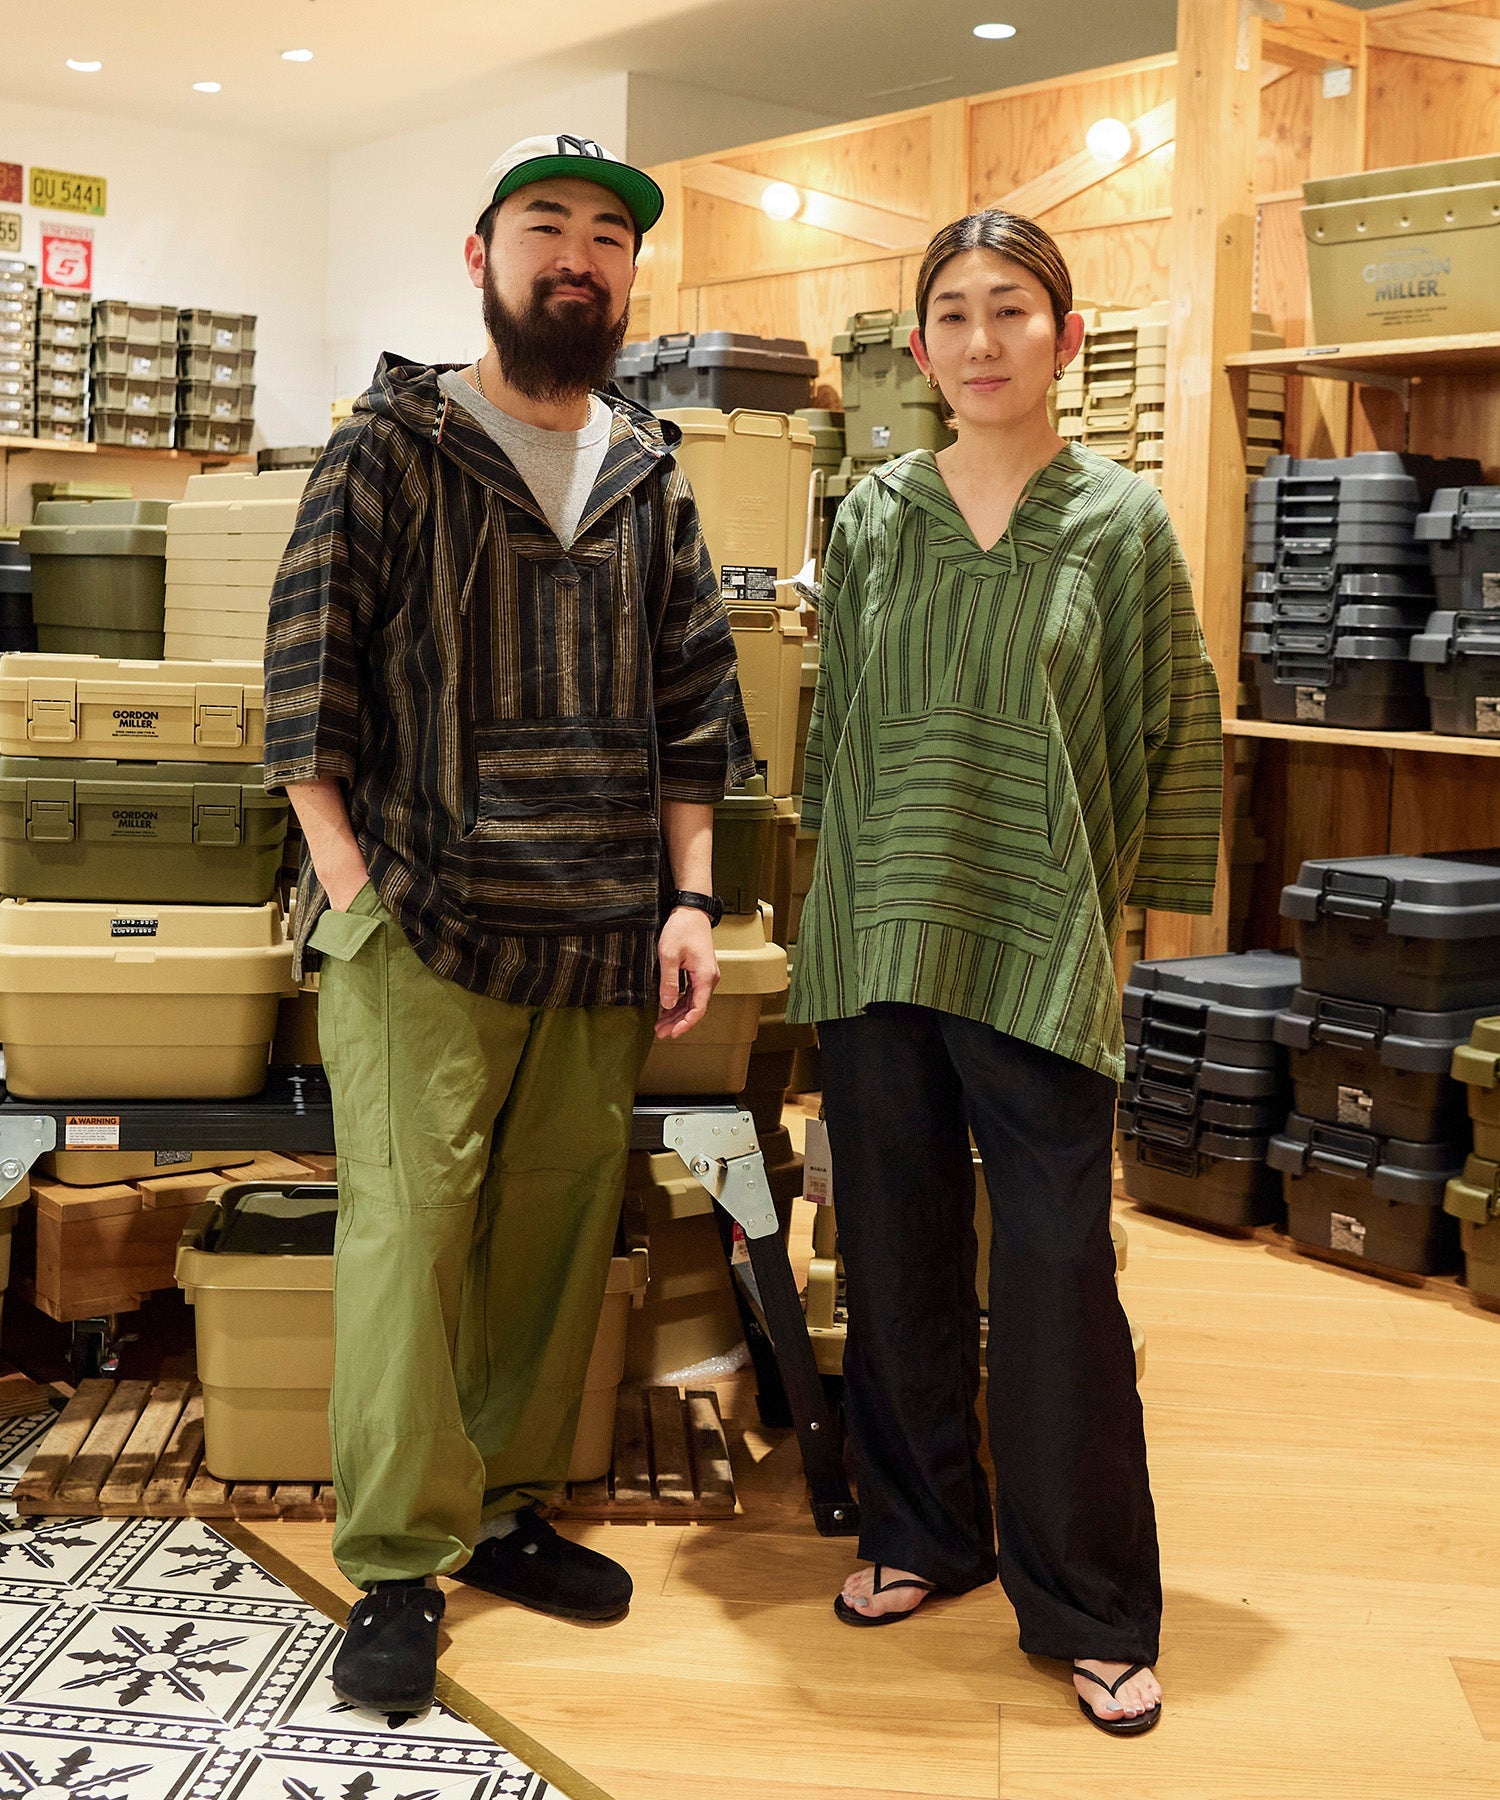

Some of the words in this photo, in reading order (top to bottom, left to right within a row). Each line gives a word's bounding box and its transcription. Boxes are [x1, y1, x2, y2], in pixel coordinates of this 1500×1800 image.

[61, 181, 101, 206] 5441
[1375, 279, 1439, 302] MILLER
[112, 710, 159, 720] GORDON
[119, 719, 153, 728] MILLER
[112, 810, 158, 820] GORDON
[118, 819, 152, 829] MILLER
[78, 1117, 117, 1125] WARNING
